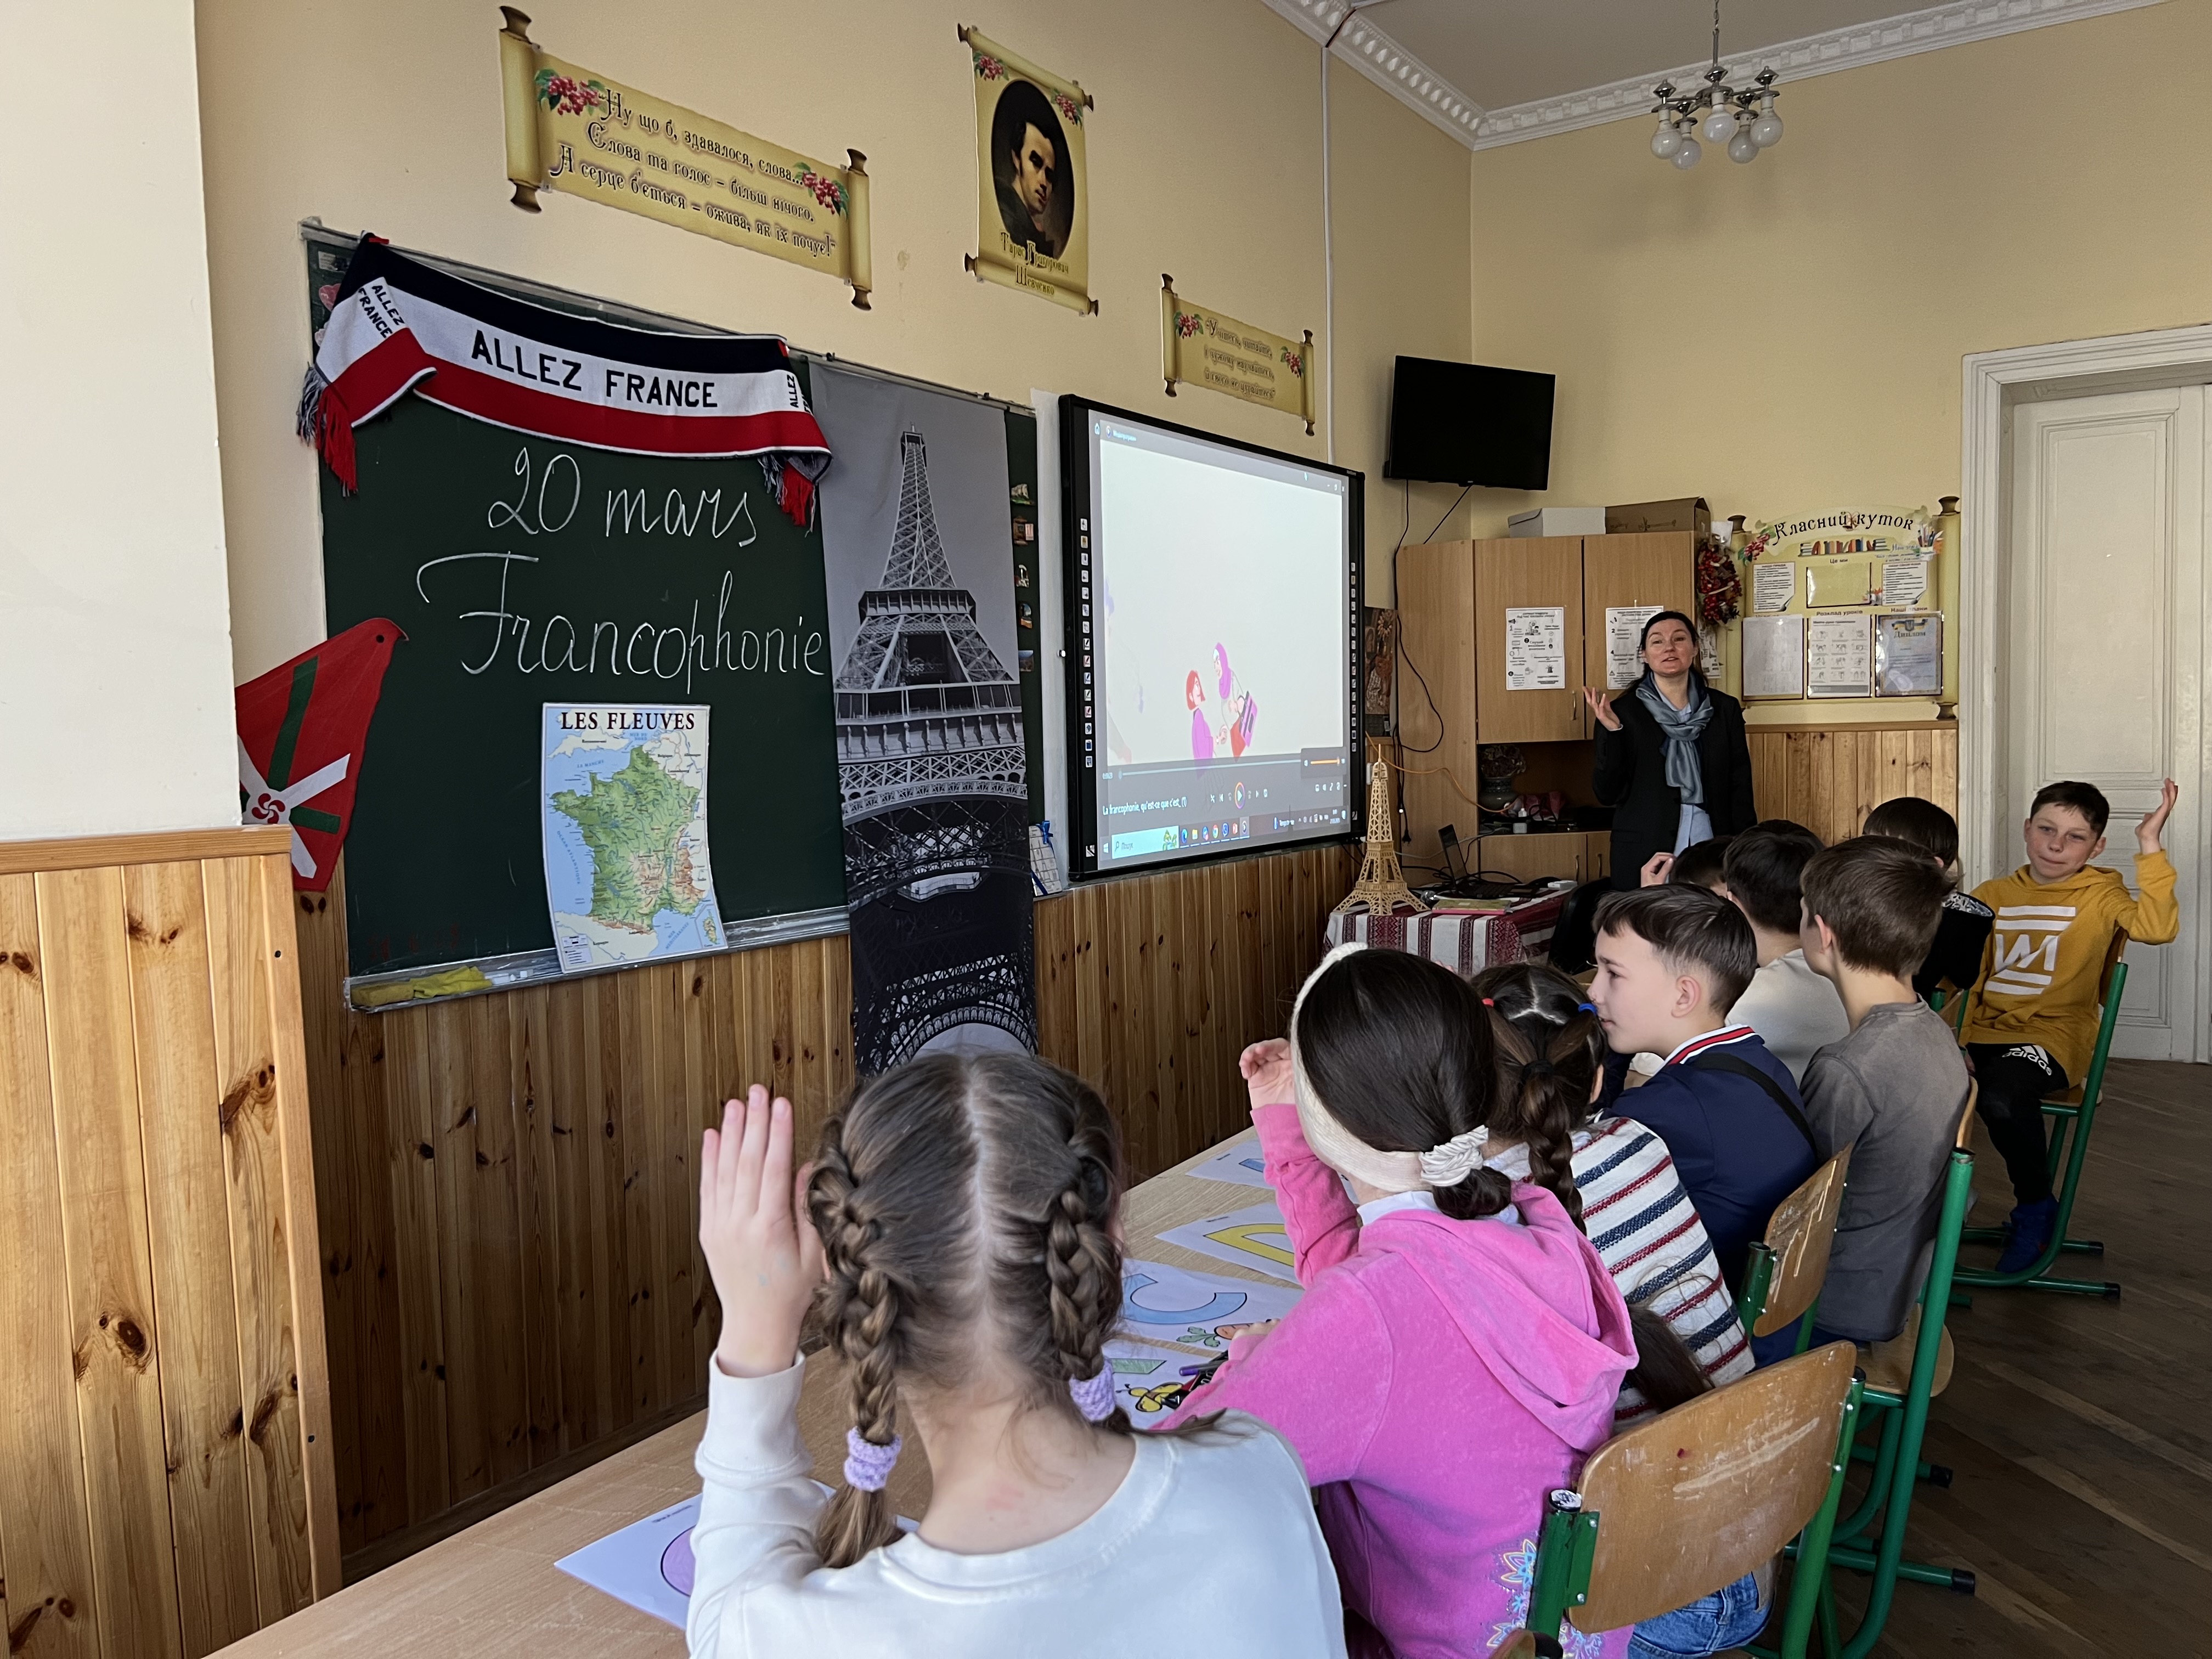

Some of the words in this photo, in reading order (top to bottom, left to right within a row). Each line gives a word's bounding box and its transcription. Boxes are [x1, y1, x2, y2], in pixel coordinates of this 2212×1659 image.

[639, 114, 659, 133] що
[665, 119, 678, 141] б,
[684, 129, 754, 169] здавалося,
[758, 159, 804, 185] слова...
[550, 145, 574, 177] А
[580, 163, 625, 191] серце
[707, 205, 751, 233] ожива,
[757, 222, 771, 238] як
[588, 122, 641, 162] Слова
[648, 153, 668, 171] та
[674, 163, 711, 186] голос
[731, 178, 768, 206] більш
[774, 197, 815, 222] нічого.
[1000, 232, 1025, 258] Тарас
[1025, 241, 1069, 274] Григорович
[1016, 265, 1054, 295] Шевченко
[358, 287, 393, 339] FRANCE
[372, 285, 405, 326] ALLEZ
[470, 329, 583, 392] ALLEZ
[605, 369, 719, 409] FRANCE
[1210, 351, 1234, 369] чужому
[786, 374, 799, 408] ALLEZ
[487, 447, 581, 534] 20
[606, 488, 758, 548] mars
[1772, 511, 1847, 546] Класний
[1857, 514, 1914, 530] куток
[416, 550, 826, 695] Francophonie
[561, 712, 598, 730] LES
[607, 713, 695, 730] FLEUVES
[1103, 805, 1109, 815] La
[1109, 801, 1140, 815] francophonie,
[1141, 800, 1160, 813] qu'est-ce
[1160, 800, 1169, 811] que
[2001, 1051, 2052, 1076] adidas
